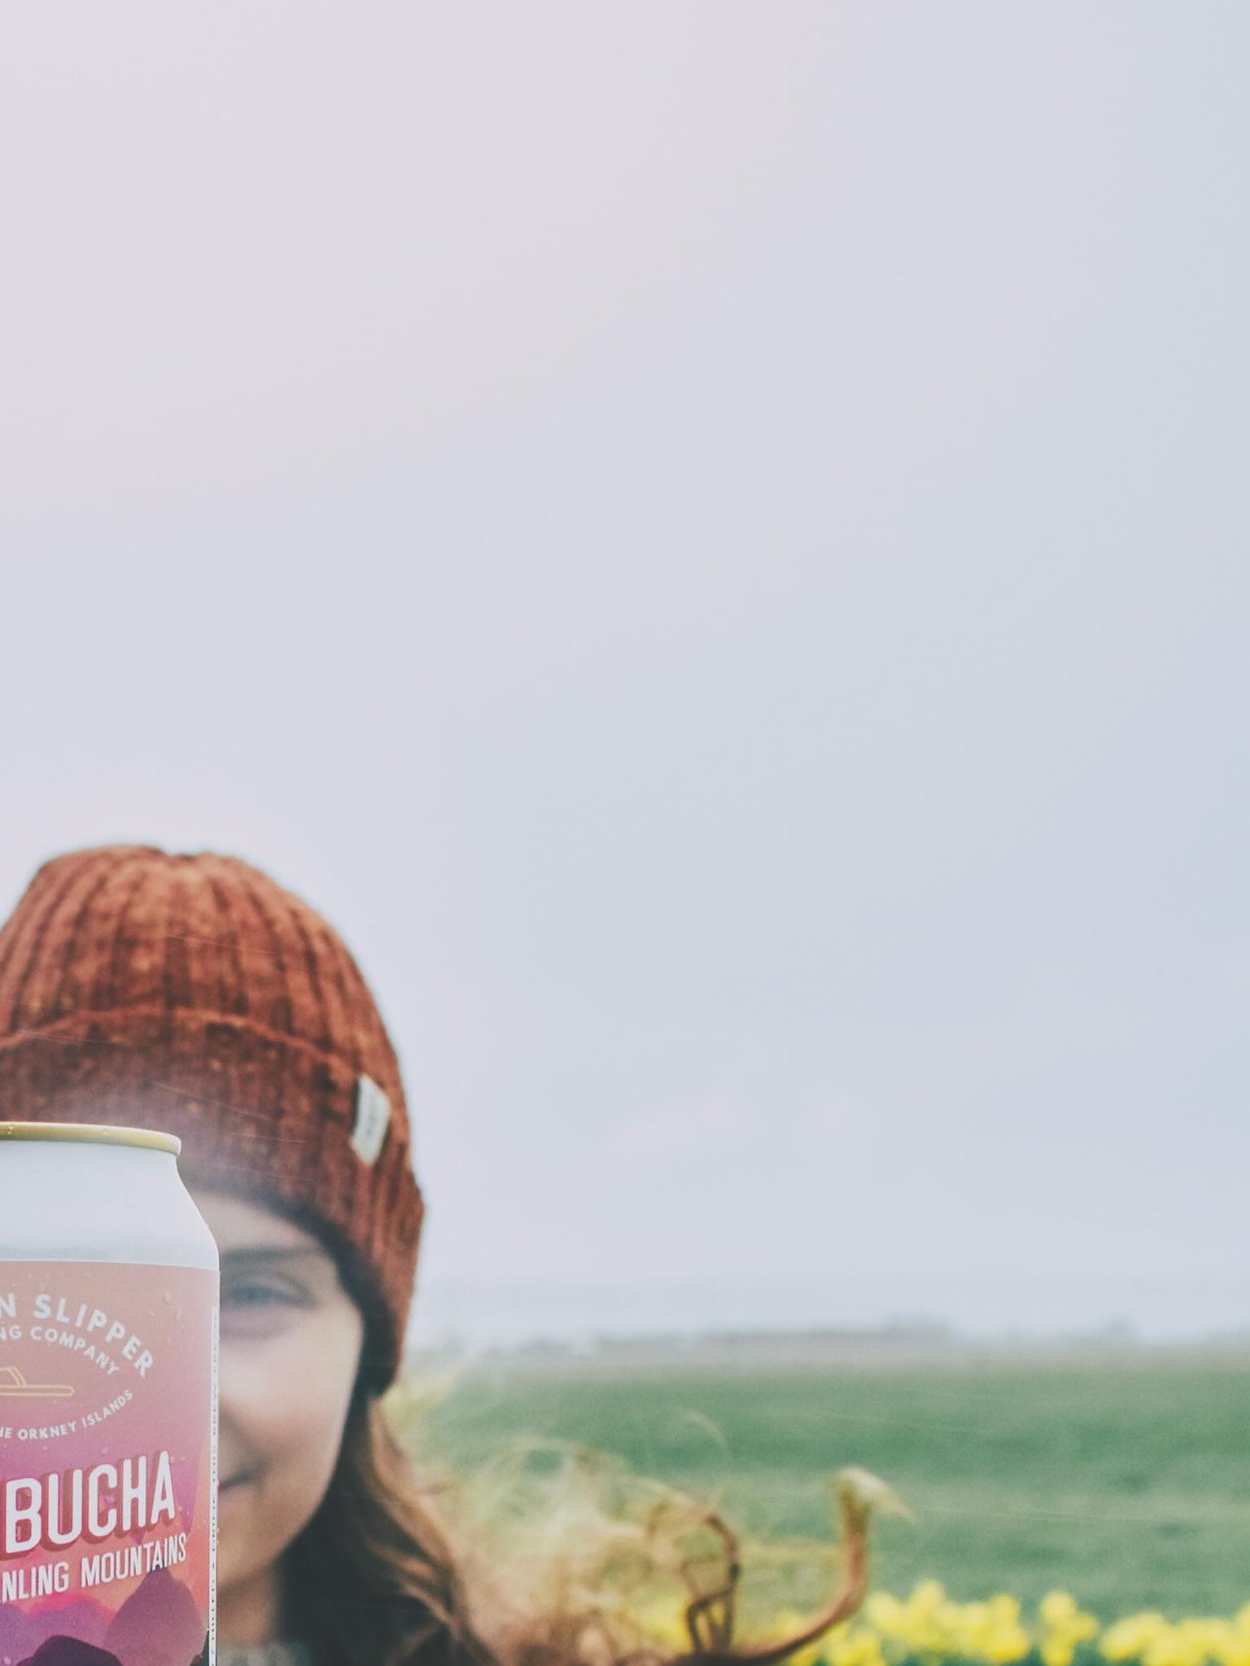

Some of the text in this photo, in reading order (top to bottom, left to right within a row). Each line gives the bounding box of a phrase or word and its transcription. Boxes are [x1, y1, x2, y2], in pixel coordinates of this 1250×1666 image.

[30, 1326, 120, 1375] COMPANY
[33, 1294, 154, 1378] SLIPPER
[17, 1420, 77, 1440] ORKNEY
[81, 1388, 133, 1428] ISLANDS
[80, 1532, 188, 1588] MOUNTAINS
